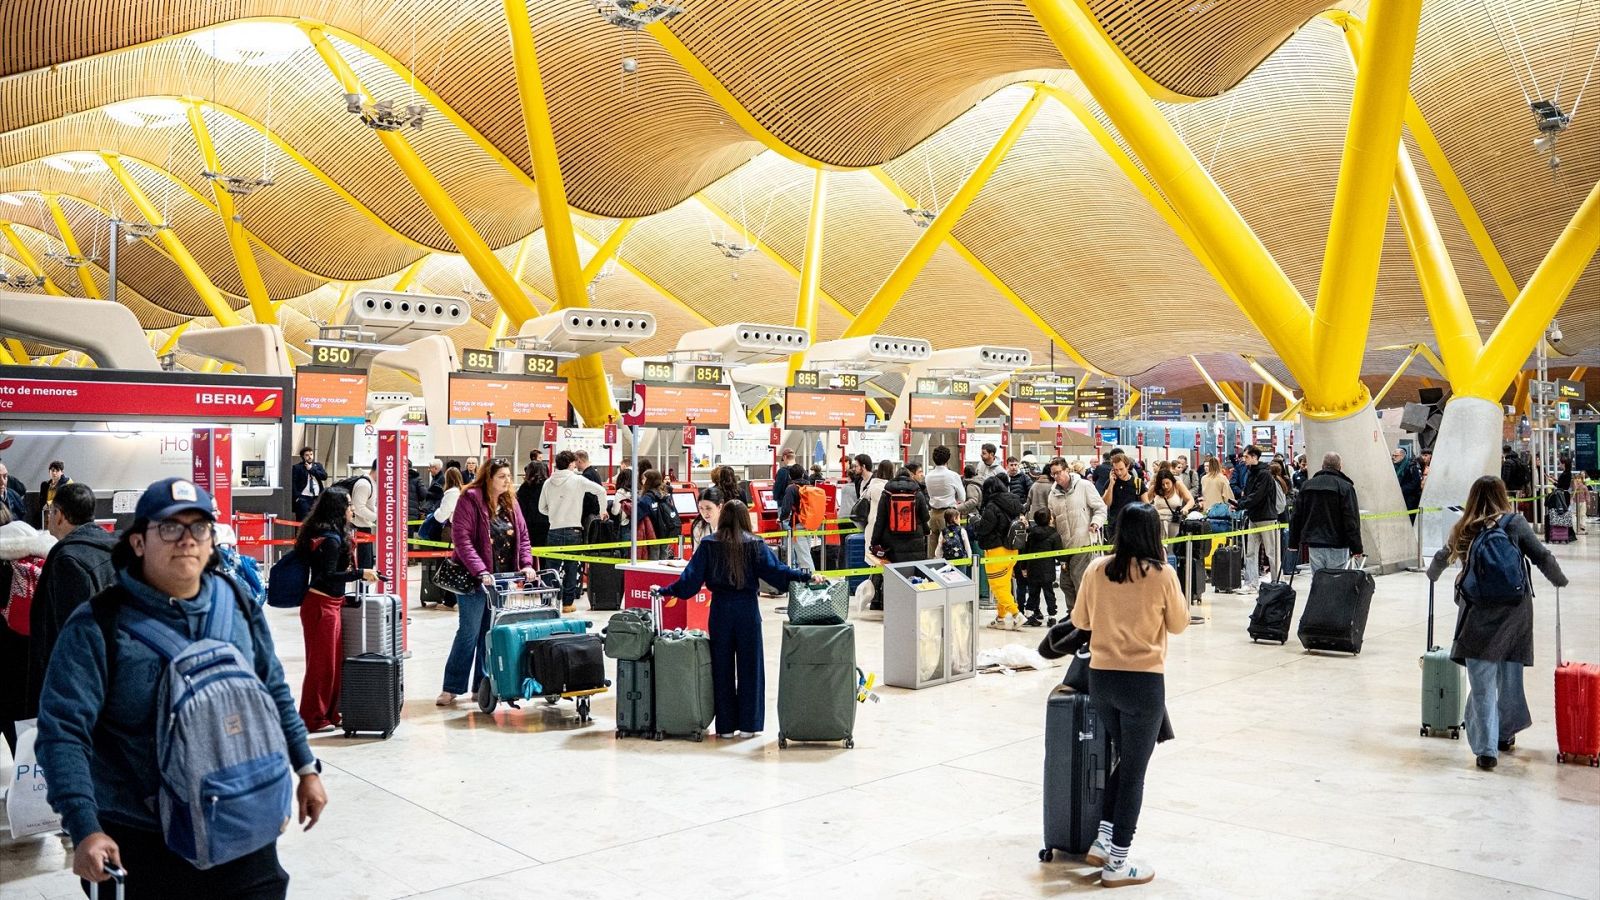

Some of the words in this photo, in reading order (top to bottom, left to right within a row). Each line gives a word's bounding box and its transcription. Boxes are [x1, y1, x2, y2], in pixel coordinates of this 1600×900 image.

[318, 346, 350, 363] 850
[468, 352, 494, 368] 851
[528, 358, 554, 373] 852
[648, 364, 670, 378] 853
[697, 368, 720, 380] 854
[798, 372, 816, 385] 855
[18, 386, 30, 394] de
[920, 380, 935, 391] 857
[953, 382, 968, 392] 858
[1020, 386, 1034, 396] 859
[196, 393, 254, 405] IBERIA
[384, 455, 396, 533] acompañados
[386, 536, 393, 550] no
[696, 594, 706, 602] IB
[1128, 867, 1137, 877] N
